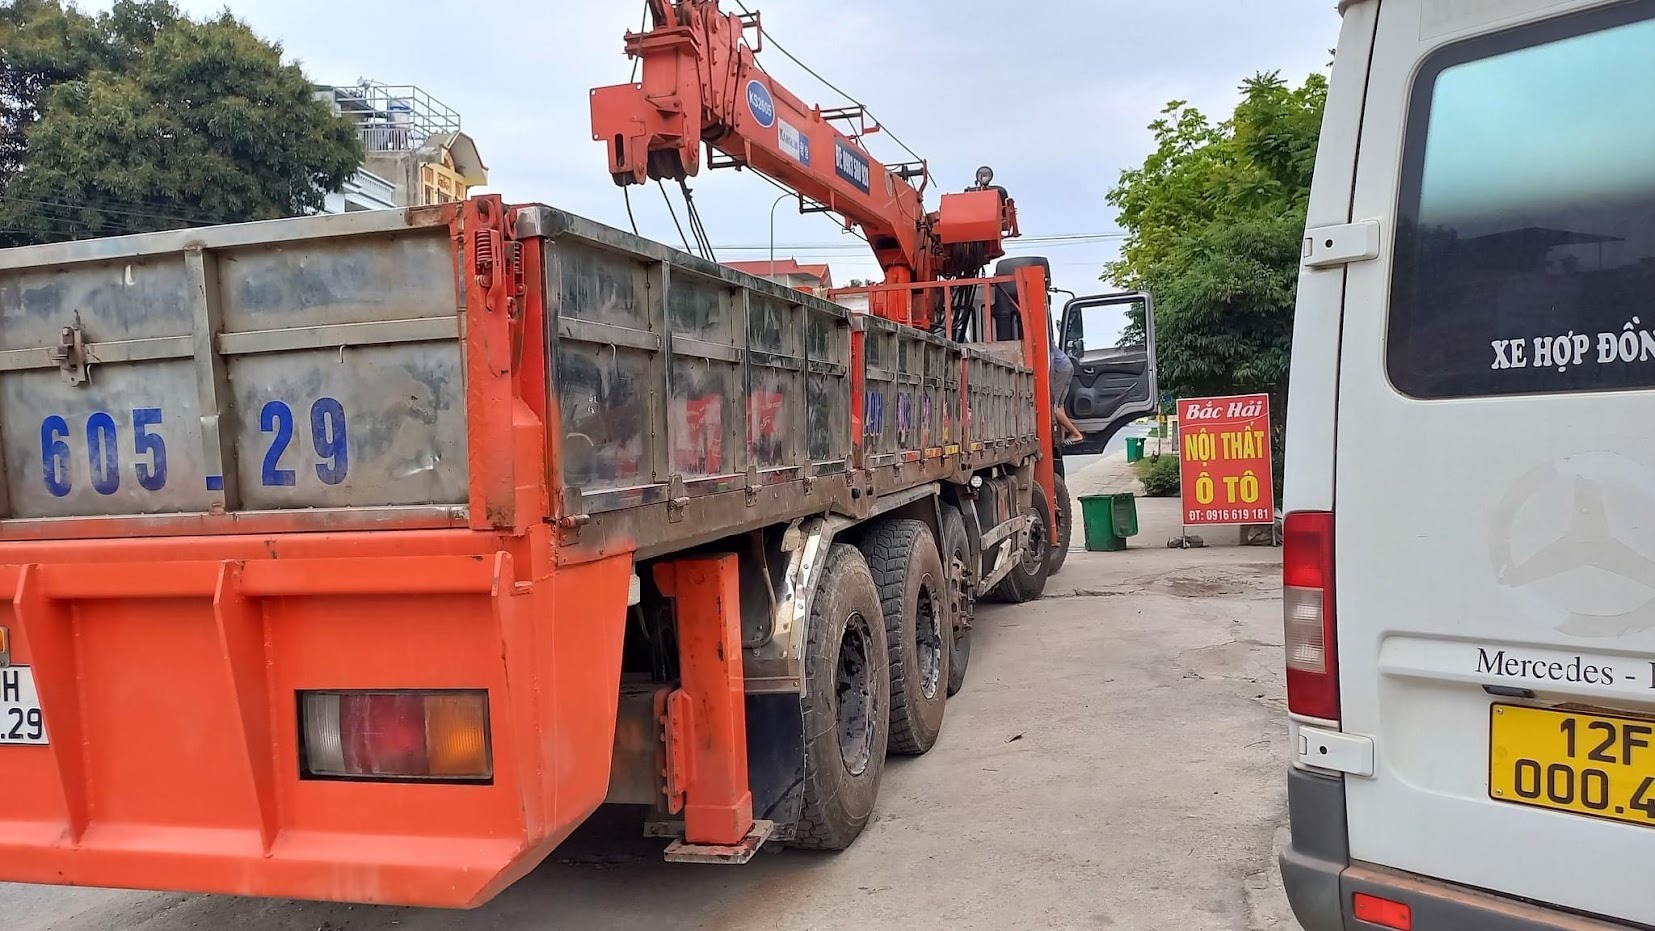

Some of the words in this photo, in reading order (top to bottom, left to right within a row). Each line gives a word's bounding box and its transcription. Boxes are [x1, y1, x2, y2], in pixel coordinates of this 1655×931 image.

[1491, 338, 1527, 370] XE
[1533, 330, 1590, 373] HỢP
[1186, 401, 1223, 420] Bắc
[1226, 401, 1262, 418] Hải
[1184, 427, 1216, 467] NỘI
[1221, 421, 1265, 460] THẤT
[1195, 471, 1214, 505] Ô
[1223, 470, 1259, 504] TÔ
[1189, 510, 1204, 521] ĐT:
[1206, 510, 1229, 521] 0916
[1231, 509, 1249, 520] 619
[1252, 508, 1268, 519] 181
[1475, 647, 1614, 686] Mercedes
[1560, 717, 1652, 766] 12F
[1514, 758, 1655, 819] 000.4
